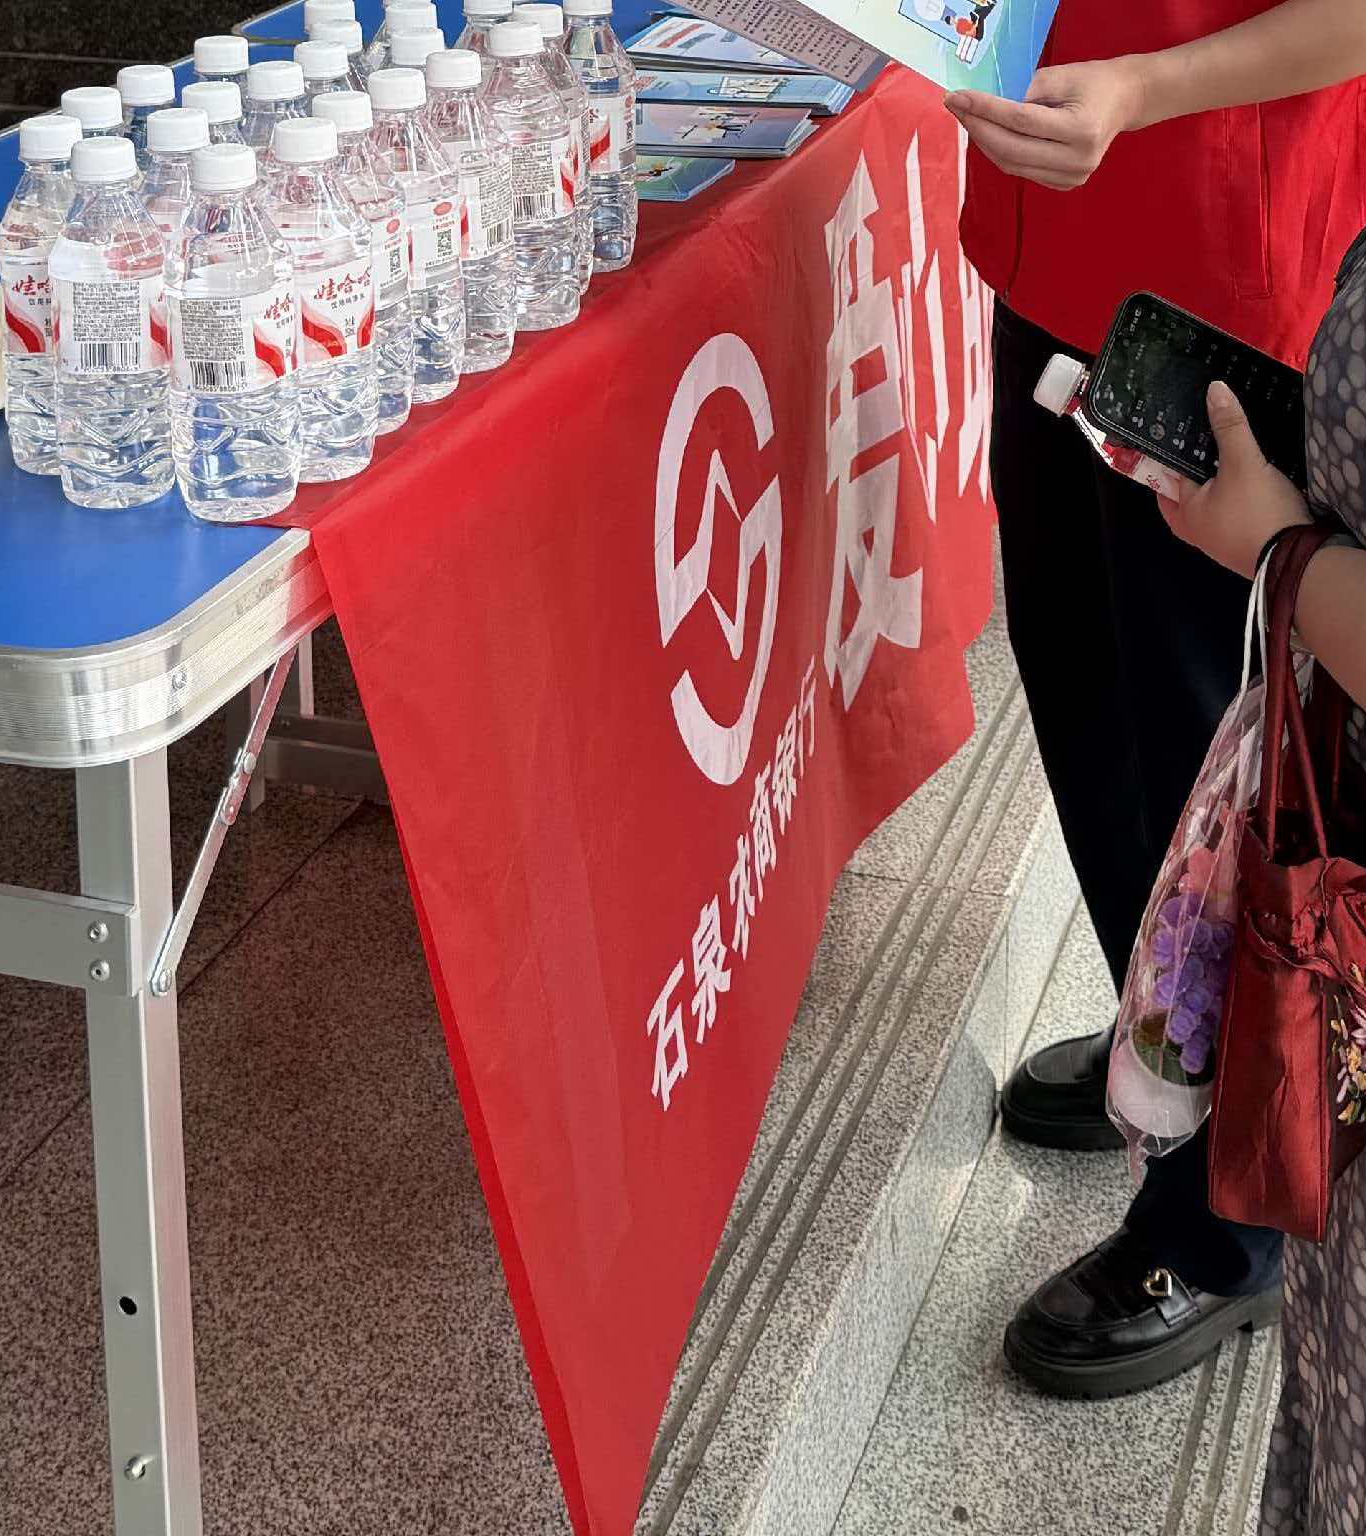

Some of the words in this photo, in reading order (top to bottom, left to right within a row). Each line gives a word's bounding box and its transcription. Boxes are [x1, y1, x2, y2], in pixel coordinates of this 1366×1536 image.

[646, 654, 817, 1112] 石泉农商银行
